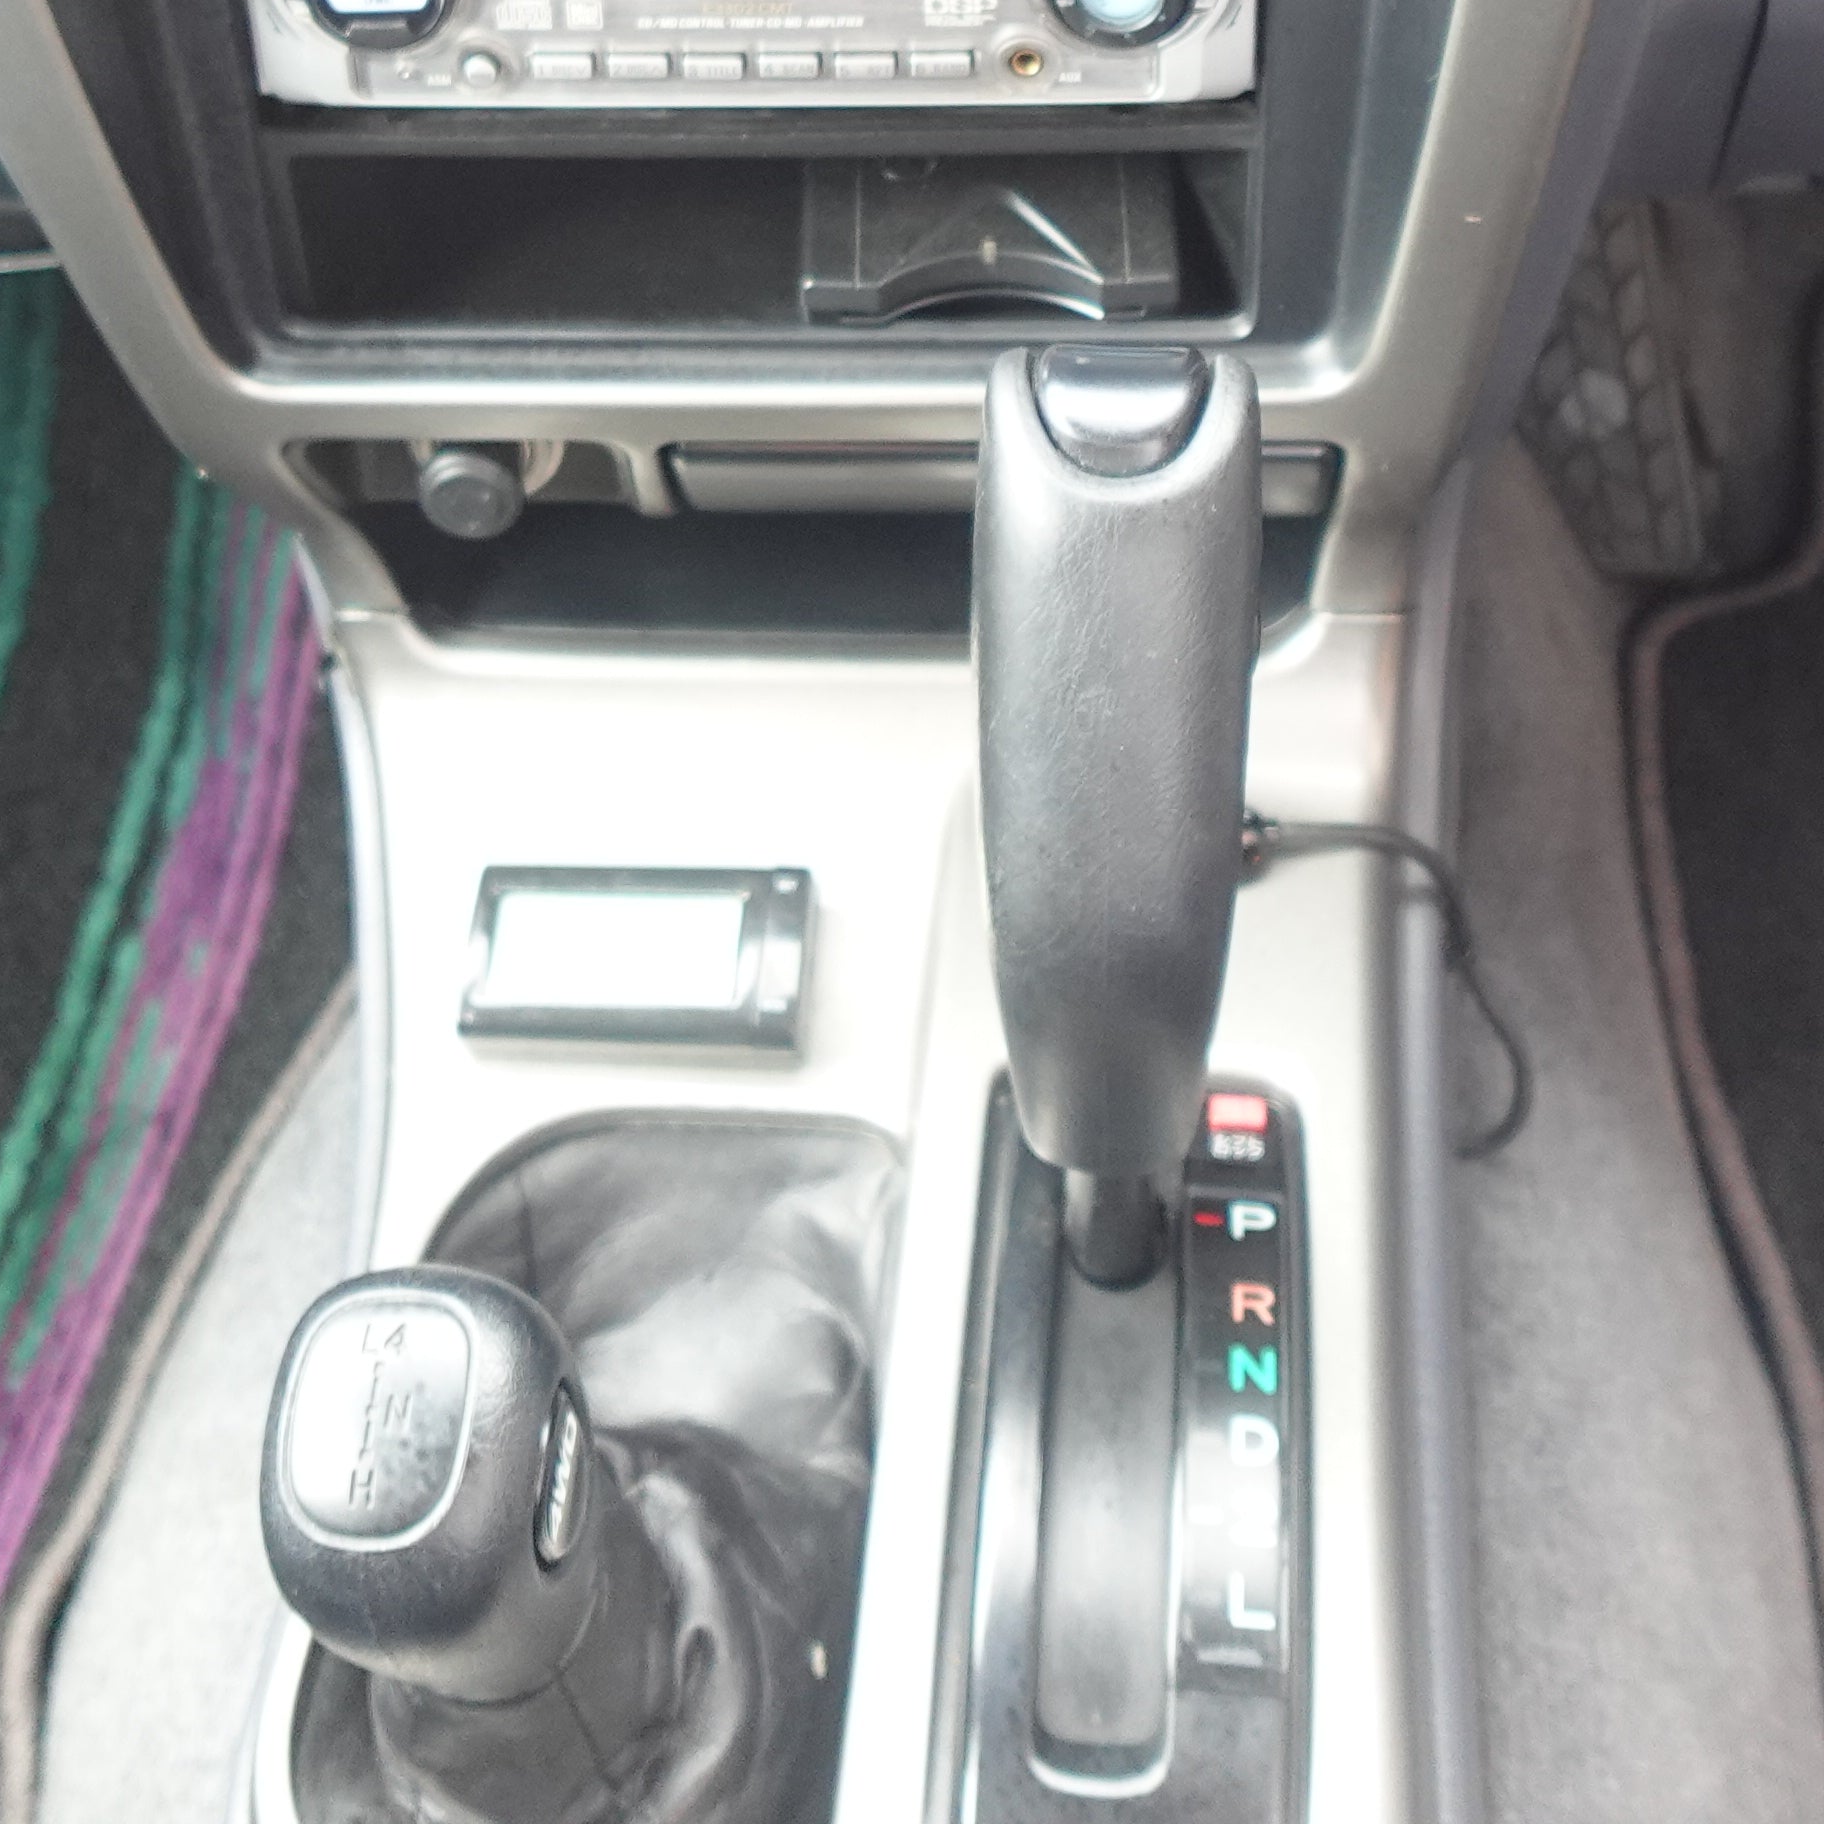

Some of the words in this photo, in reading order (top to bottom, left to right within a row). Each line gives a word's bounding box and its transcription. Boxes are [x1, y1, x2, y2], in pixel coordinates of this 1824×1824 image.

[1229, 1202, 1277, 1241] P
[1229, 1281, 1276, 1327] R
[1228, 1342, 1278, 1396] N
[383, 1393, 413, 1430] N
[1228, 1412, 1280, 1470] D
[1228, 1570, 1277, 1632] L
